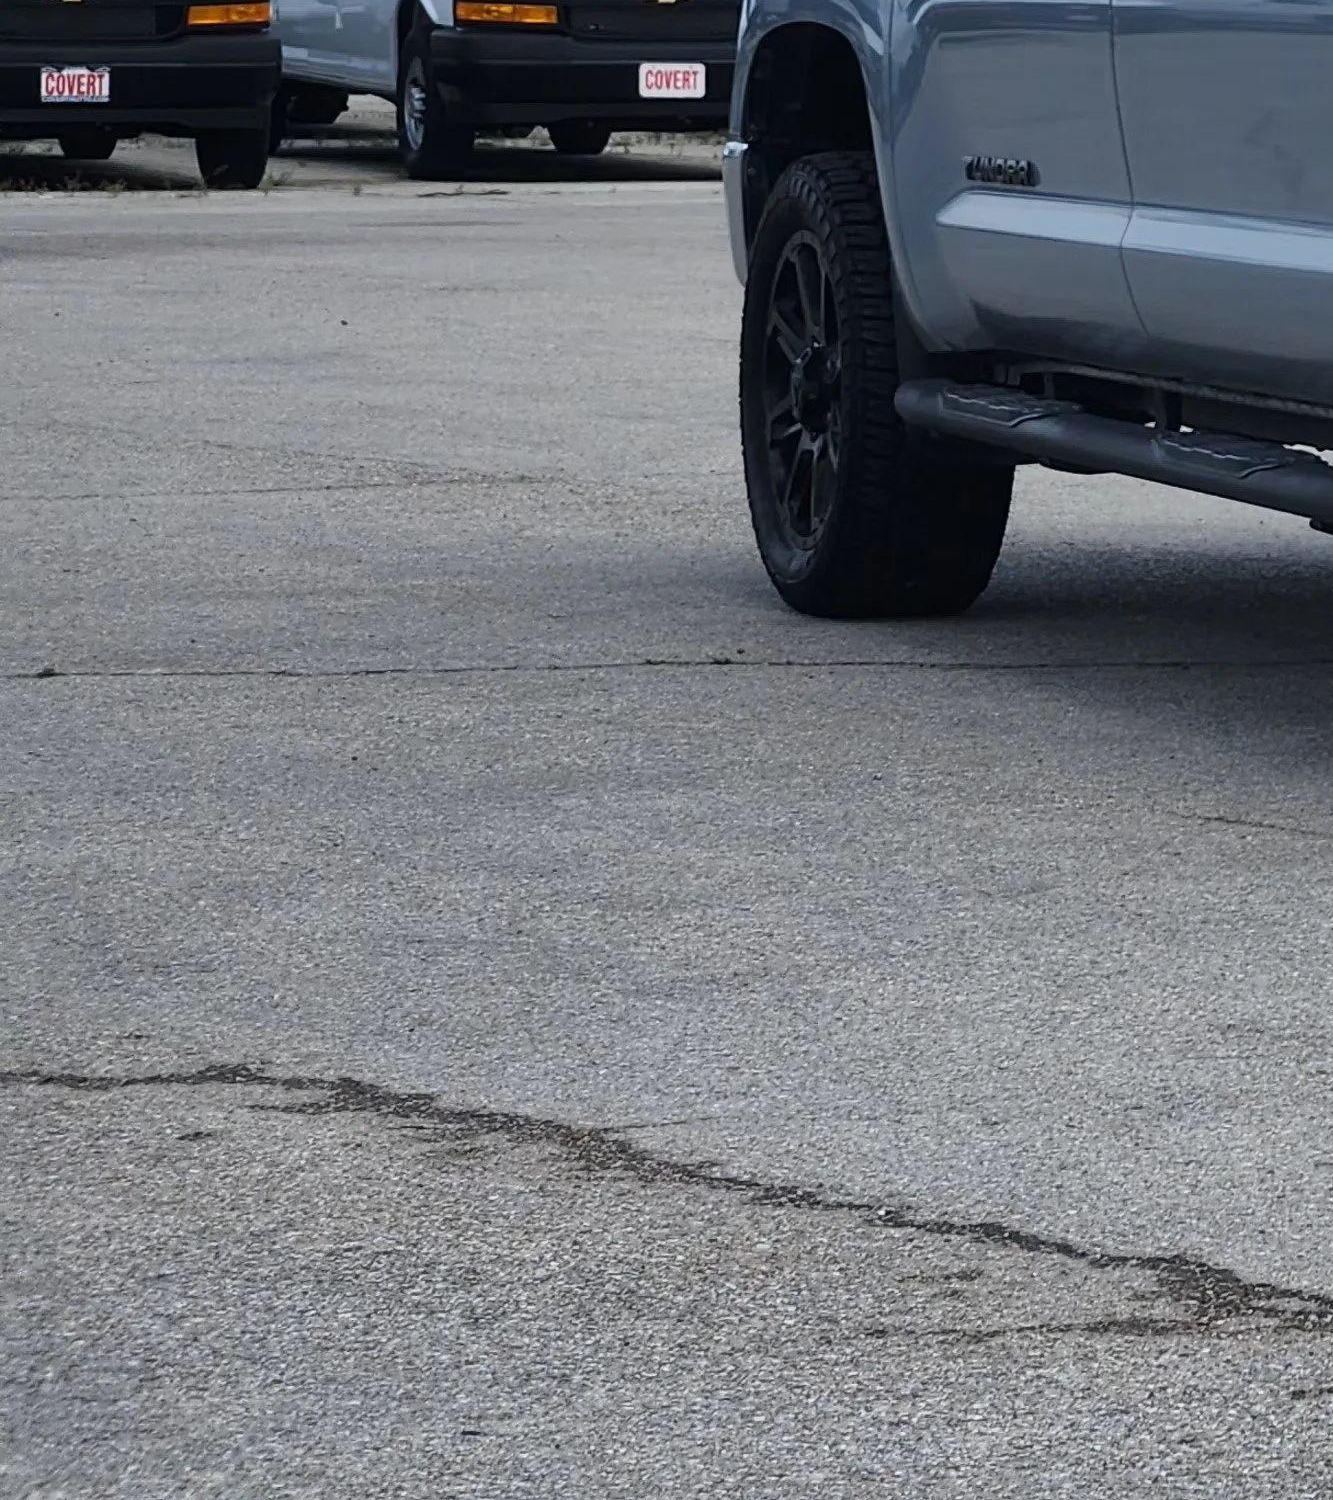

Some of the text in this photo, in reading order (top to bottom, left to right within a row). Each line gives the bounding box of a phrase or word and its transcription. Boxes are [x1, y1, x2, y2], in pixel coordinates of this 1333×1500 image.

[45, 72, 105, 96] COVERT
[645, 69, 699, 90] COVERT
[962, 155, 1034, 186] TUNDRA
